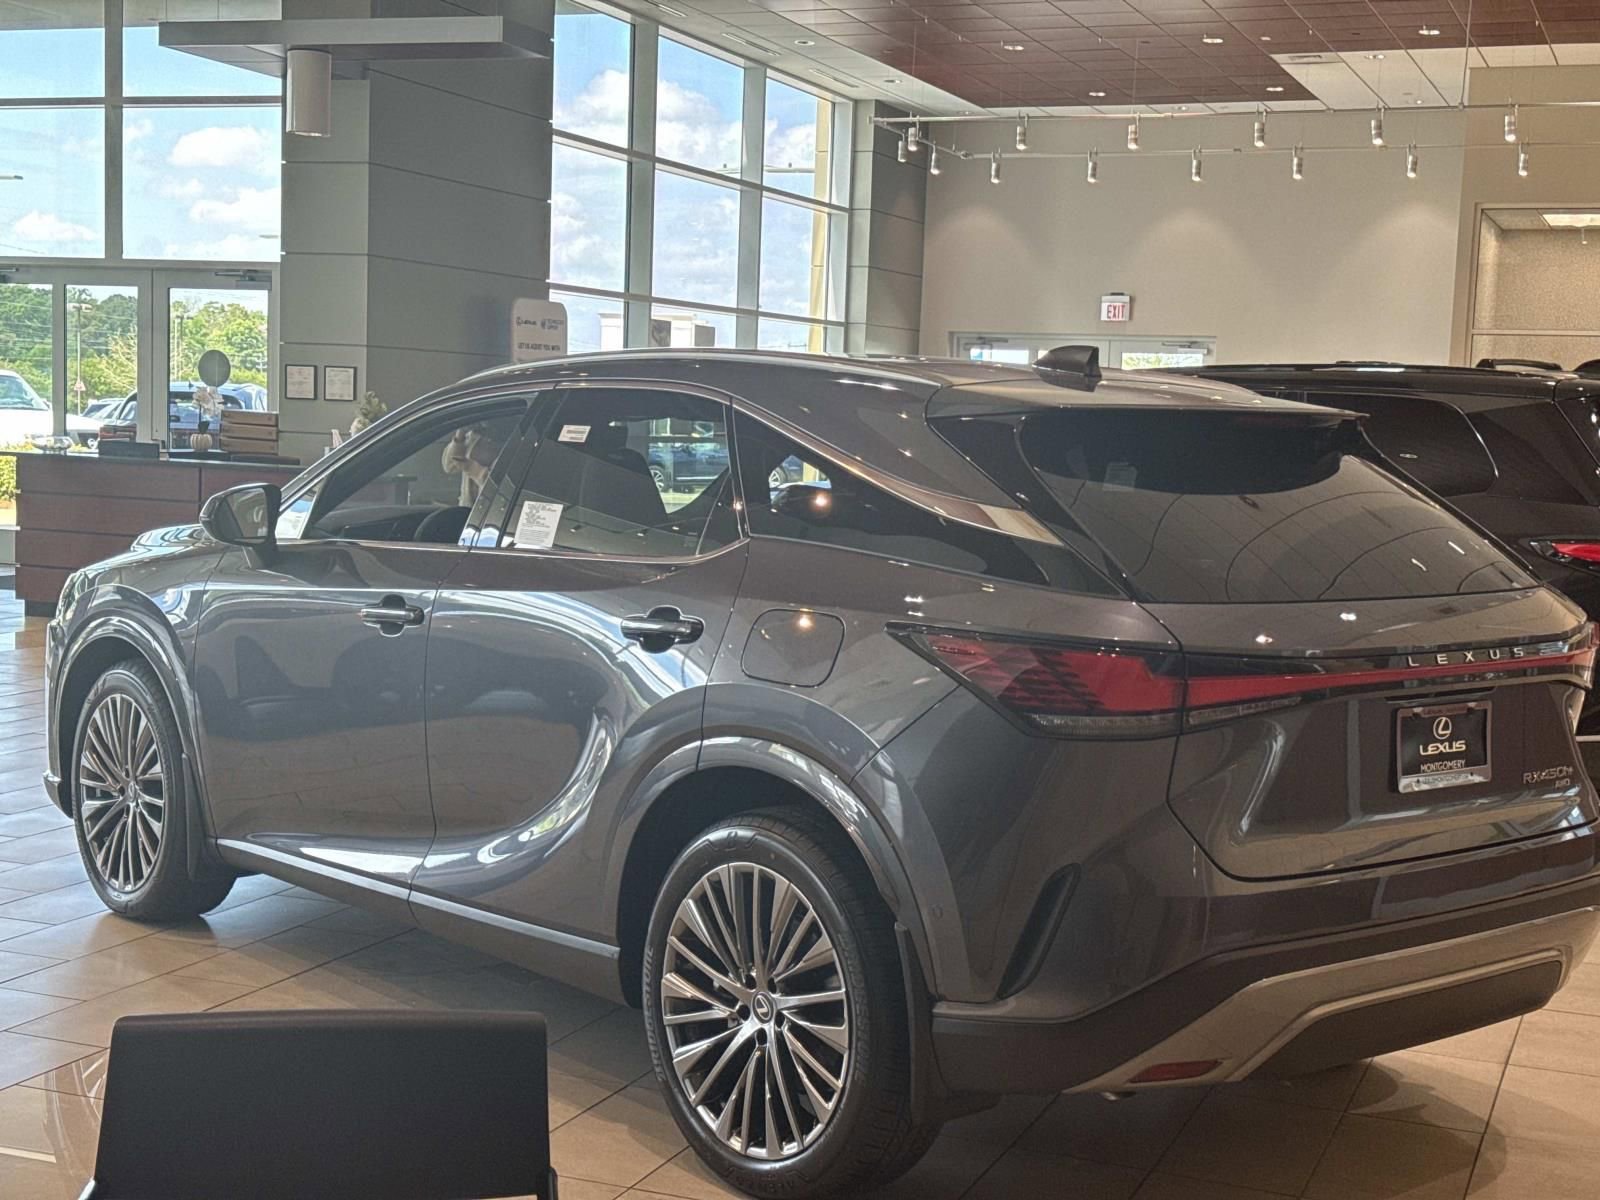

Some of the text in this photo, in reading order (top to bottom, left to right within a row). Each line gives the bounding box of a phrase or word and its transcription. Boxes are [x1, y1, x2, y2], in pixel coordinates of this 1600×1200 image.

[1106, 304, 1126, 319] EXIT
[1407, 647, 1524, 667] LEXUS
[1419, 740, 1467, 756] LEXUS
[1420, 759, 1466, 774] MONTGOMERY
